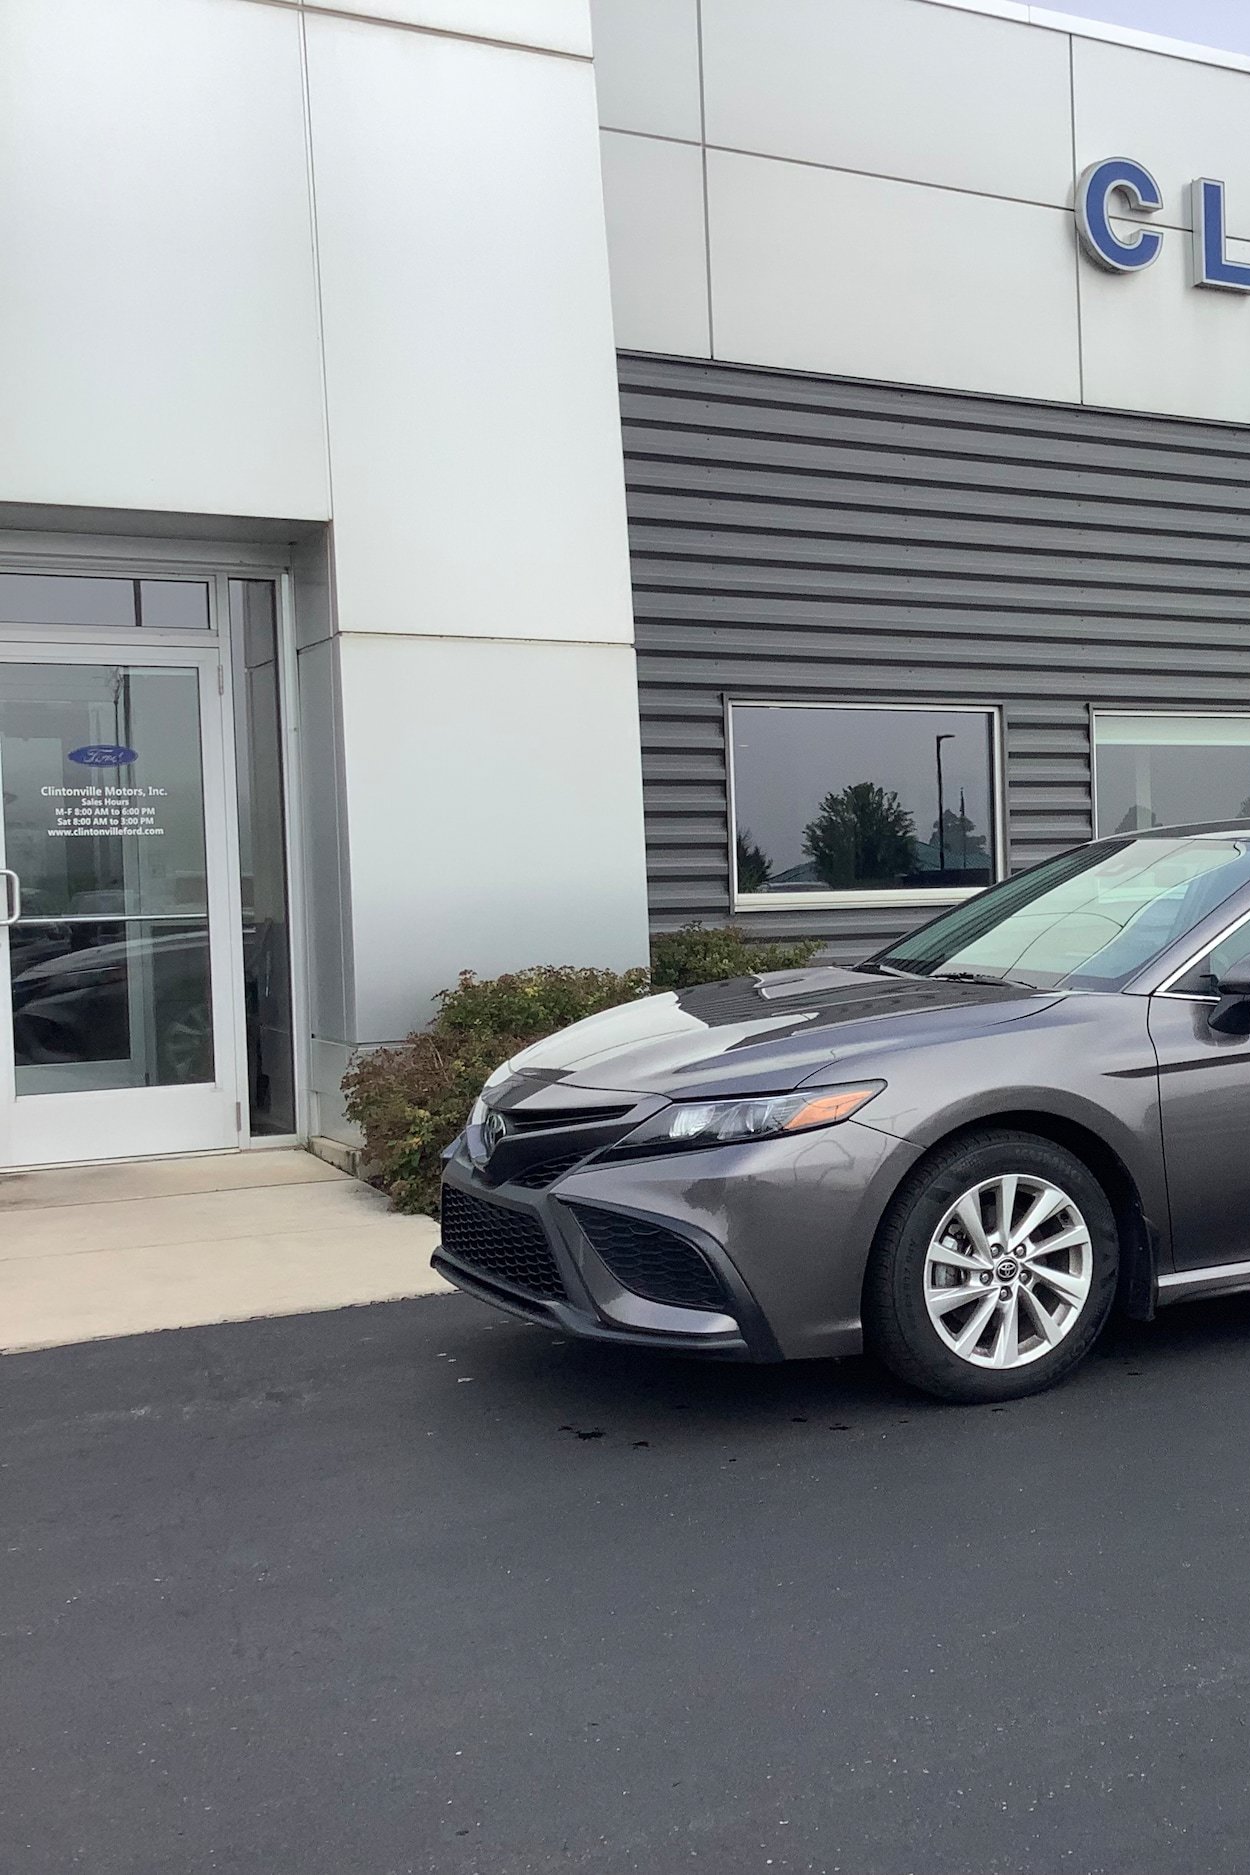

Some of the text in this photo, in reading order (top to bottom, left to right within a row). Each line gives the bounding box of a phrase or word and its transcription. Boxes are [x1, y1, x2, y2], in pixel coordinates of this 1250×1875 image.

[40, 786, 168, 797] Clintonville Motors, Inc.
[81, 798, 130, 806] Sales Hours
[55, 808, 156, 816] M-F 8:00 AM to 6:00 PM
[57, 818, 71, 826] Sat
[72, 818, 91, 826] 8:00
[92, 818, 108, 826] AM
[109, 818, 119, 826] to
[140, 817, 154, 825] PM
[47, 827, 164, 837] www.clintonvilleford.com
